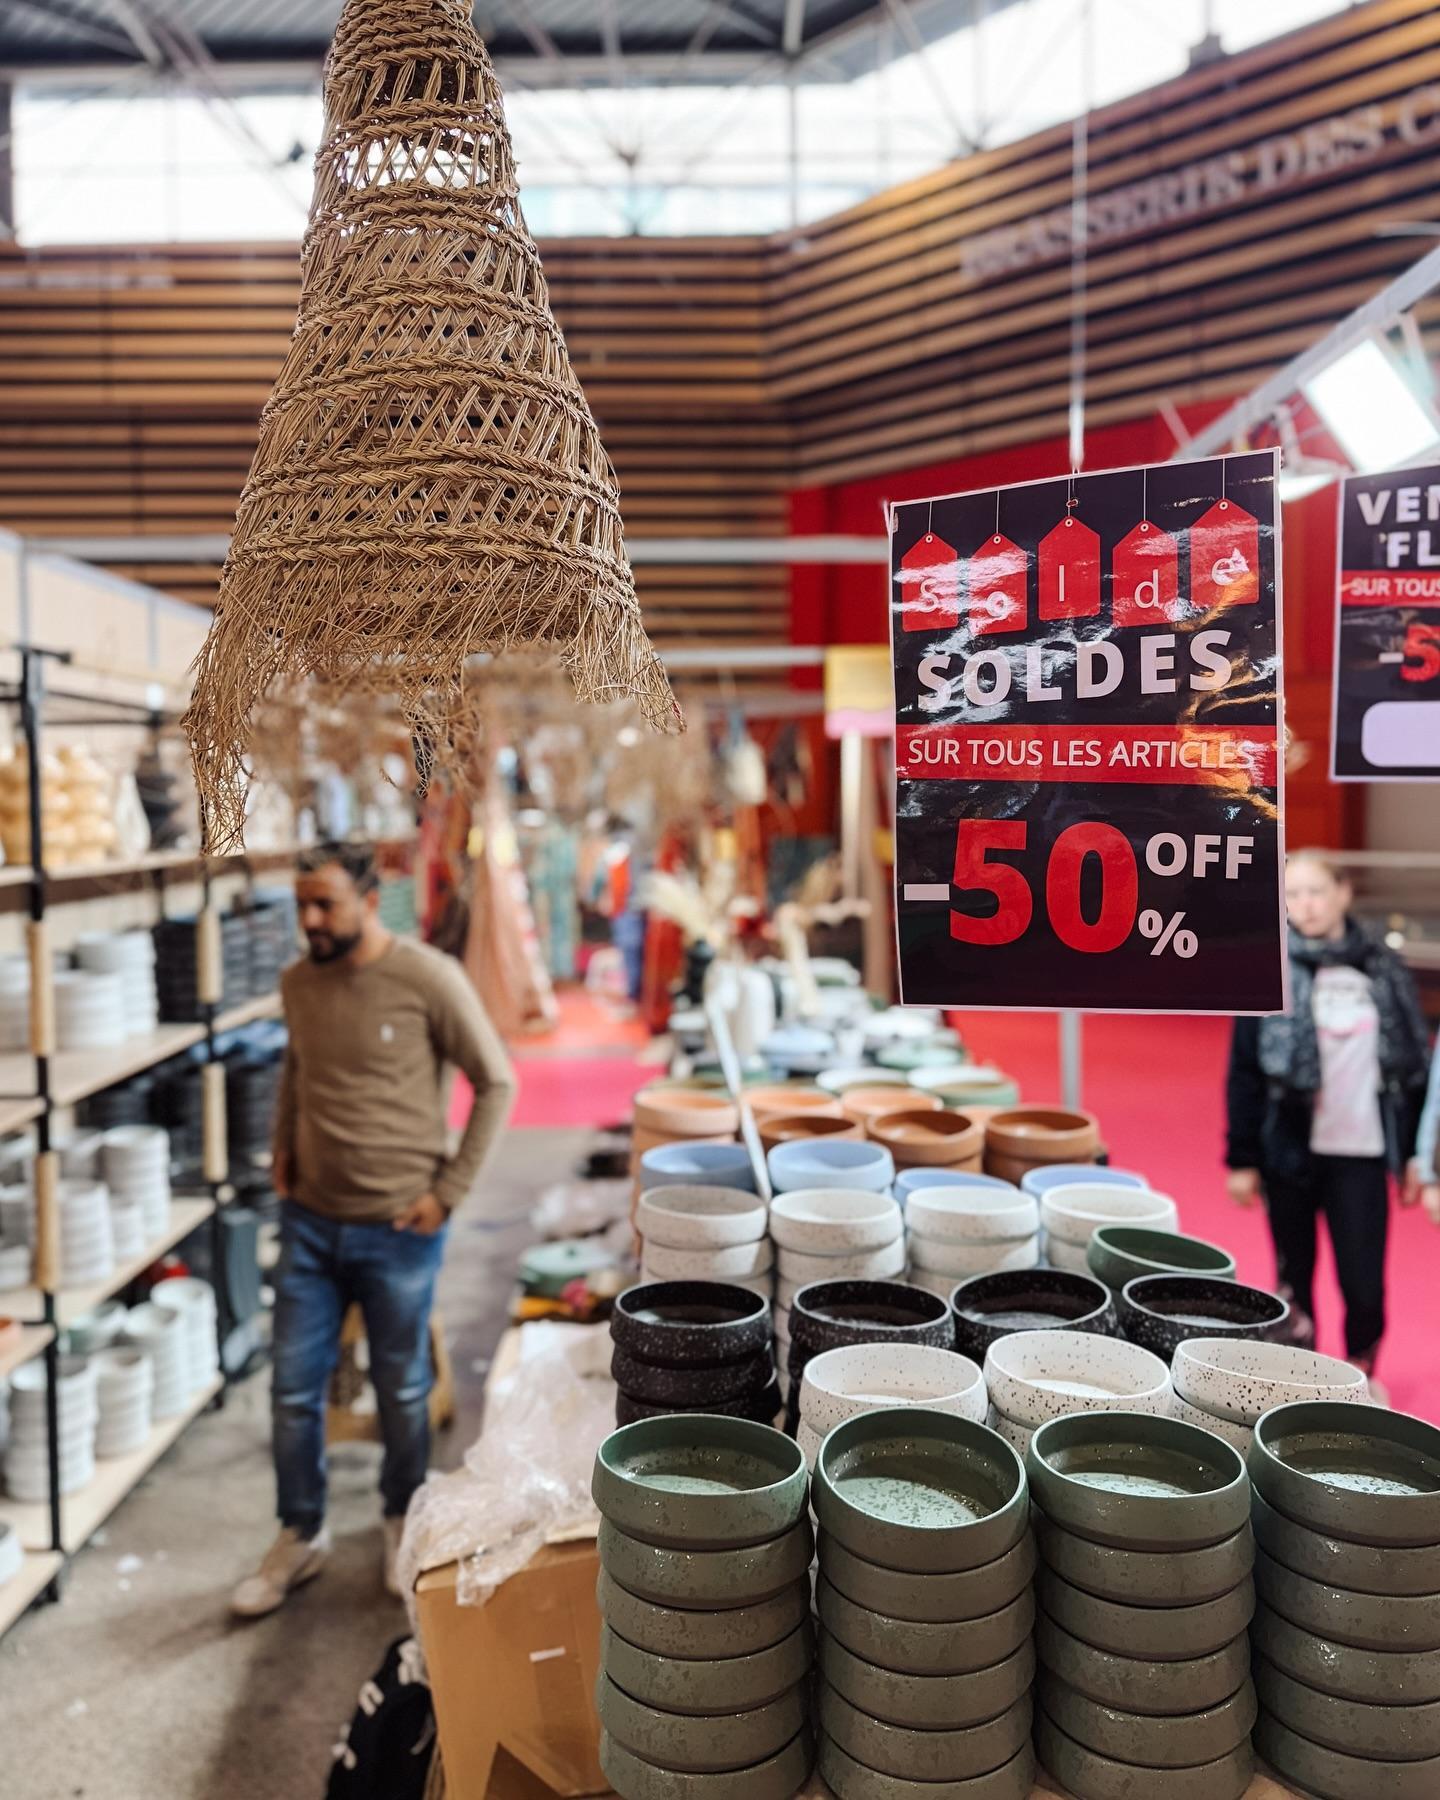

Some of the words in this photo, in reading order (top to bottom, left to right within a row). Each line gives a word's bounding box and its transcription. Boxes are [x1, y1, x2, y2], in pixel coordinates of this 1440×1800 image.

[1352, 577, 1391, 596] SUR
[917, 629, 1232, 711] SOLDES
[908, 739, 960, 765] SUR
[967, 739, 1044, 766] TOUS
[1052, 740, 1102, 767] LES
[1108, 741, 1255, 769] ARTICLES
[1145, 832, 1255, 880] OFF
